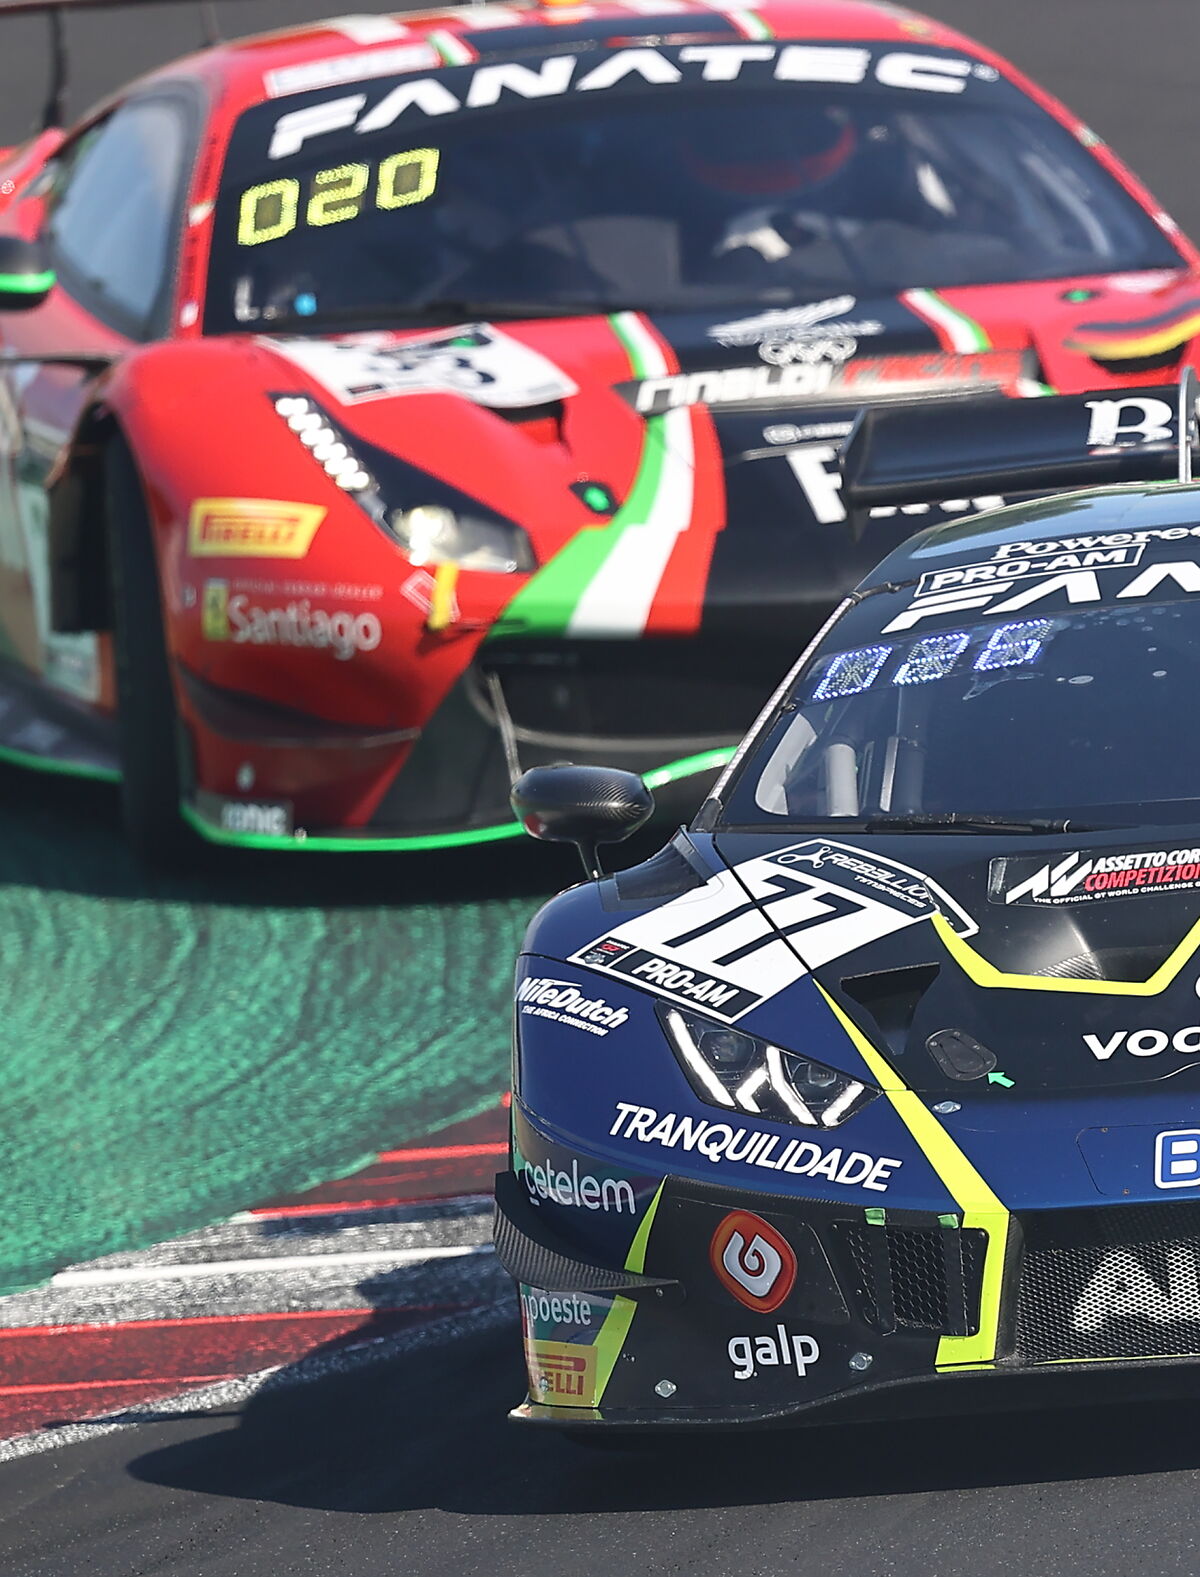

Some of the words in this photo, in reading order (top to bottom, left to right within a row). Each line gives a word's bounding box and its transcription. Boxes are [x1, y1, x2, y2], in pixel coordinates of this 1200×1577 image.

[238, 148, 440, 246] 020
[930, 547, 1131, 591] PRO-AM
[228, 594, 382, 661] Santiago
[1092, 850, 1167, 874] ASSETTO
[661, 873, 868, 966] 77
[1053, 893, 1093, 904] OFFICIAL
[1108, 888, 1139, 898] WORLD
[1140, 883, 1193, 895] CHALLENGE
[631, 957, 740, 1008] PRO-AM
[558, 1014, 609, 1036] CONNECTION
[609, 1102, 902, 1192] TRANQUILIDADE
[727, 1324, 819, 1380] galp
